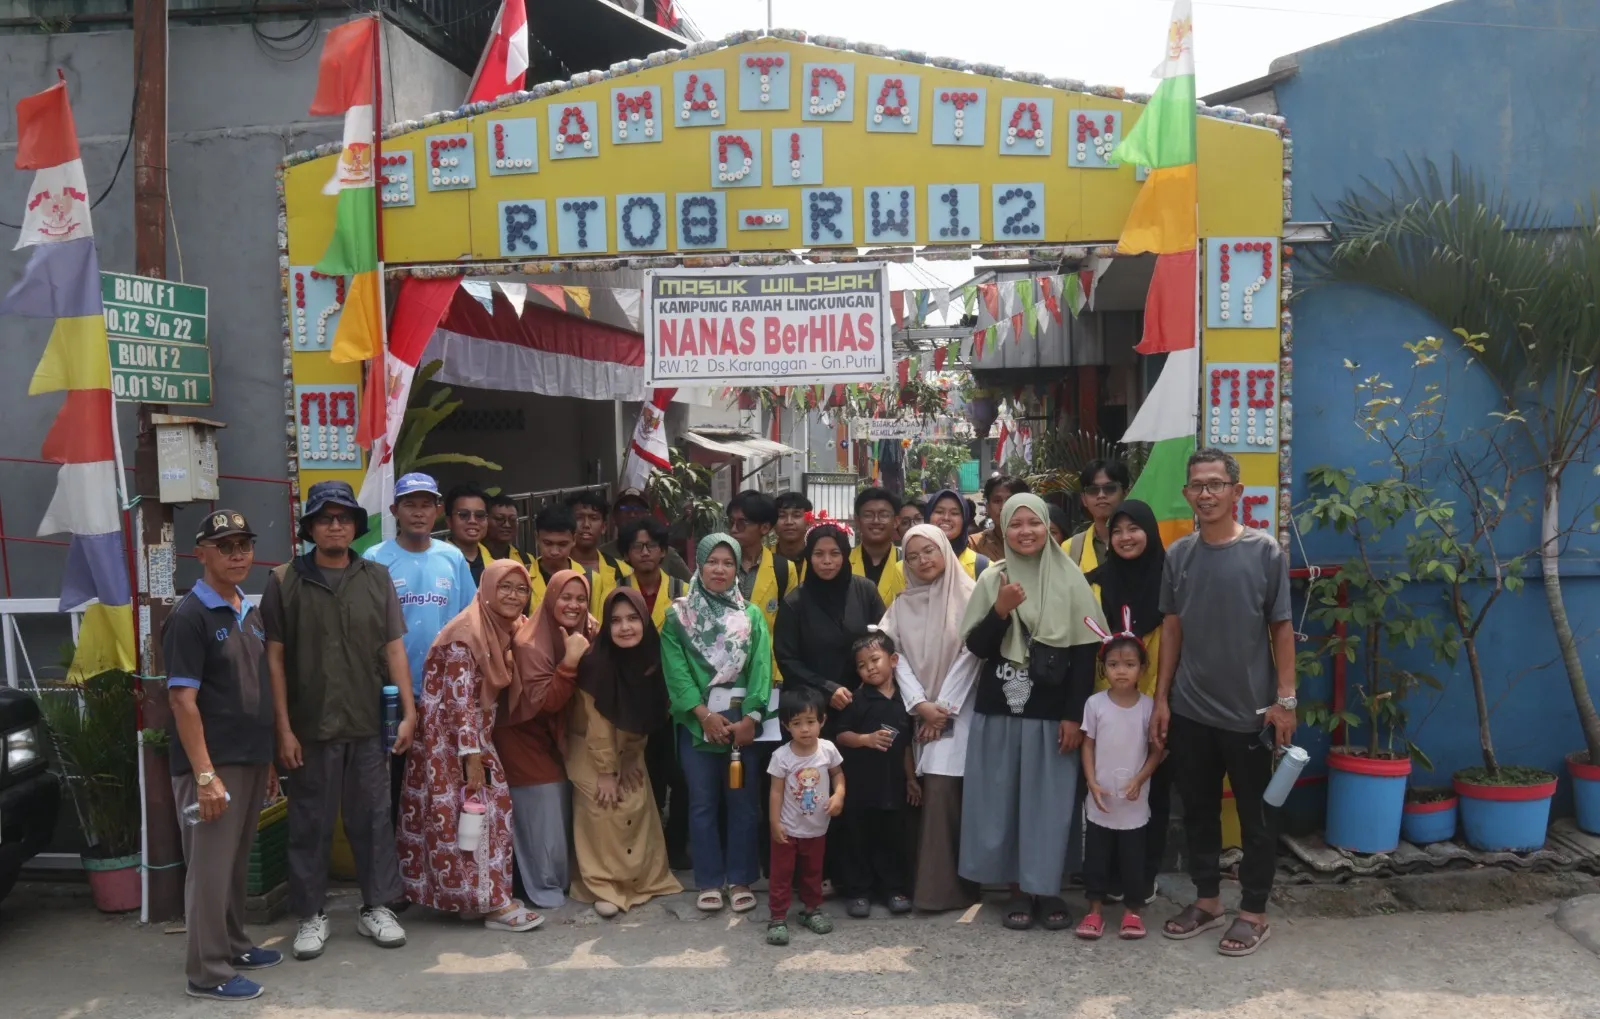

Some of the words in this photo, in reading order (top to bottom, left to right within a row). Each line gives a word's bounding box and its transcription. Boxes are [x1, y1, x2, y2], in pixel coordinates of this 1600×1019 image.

[808, 66, 1150, 176] DATAN
[717, 132, 801, 183] DI
[115, 277, 154, 306] BLOK
[156, 284, 165, 306] F
[166, 286, 175, 308] 1
[659, 279, 749, 295] MASUK
[760, 273, 875, 294] WILAYAH
[1219, 241, 1274, 322] 17
[294, 269, 346, 344] 17
[659, 299, 728, 314] KAMPUNG
[732, 297, 782, 312] RAMAH
[786, 295, 875, 312] LINGKUNGAN
[173, 317, 192, 341] 22
[659, 316, 756, 358] NANAS
[763, 312, 875, 355] BerHIAS
[118, 343, 158, 368] BLOK
[160, 346, 169, 369] F
[170, 347, 181, 369] 2
[659, 358, 699, 374] RW.12
[707, 357, 807, 376] Ds.Karanggan
[821, 354, 877, 370] Gn.Putri
[181, 378, 198, 401] 11
[1210, 368, 1276, 446] 08
[300, 391, 357, 462] 08
